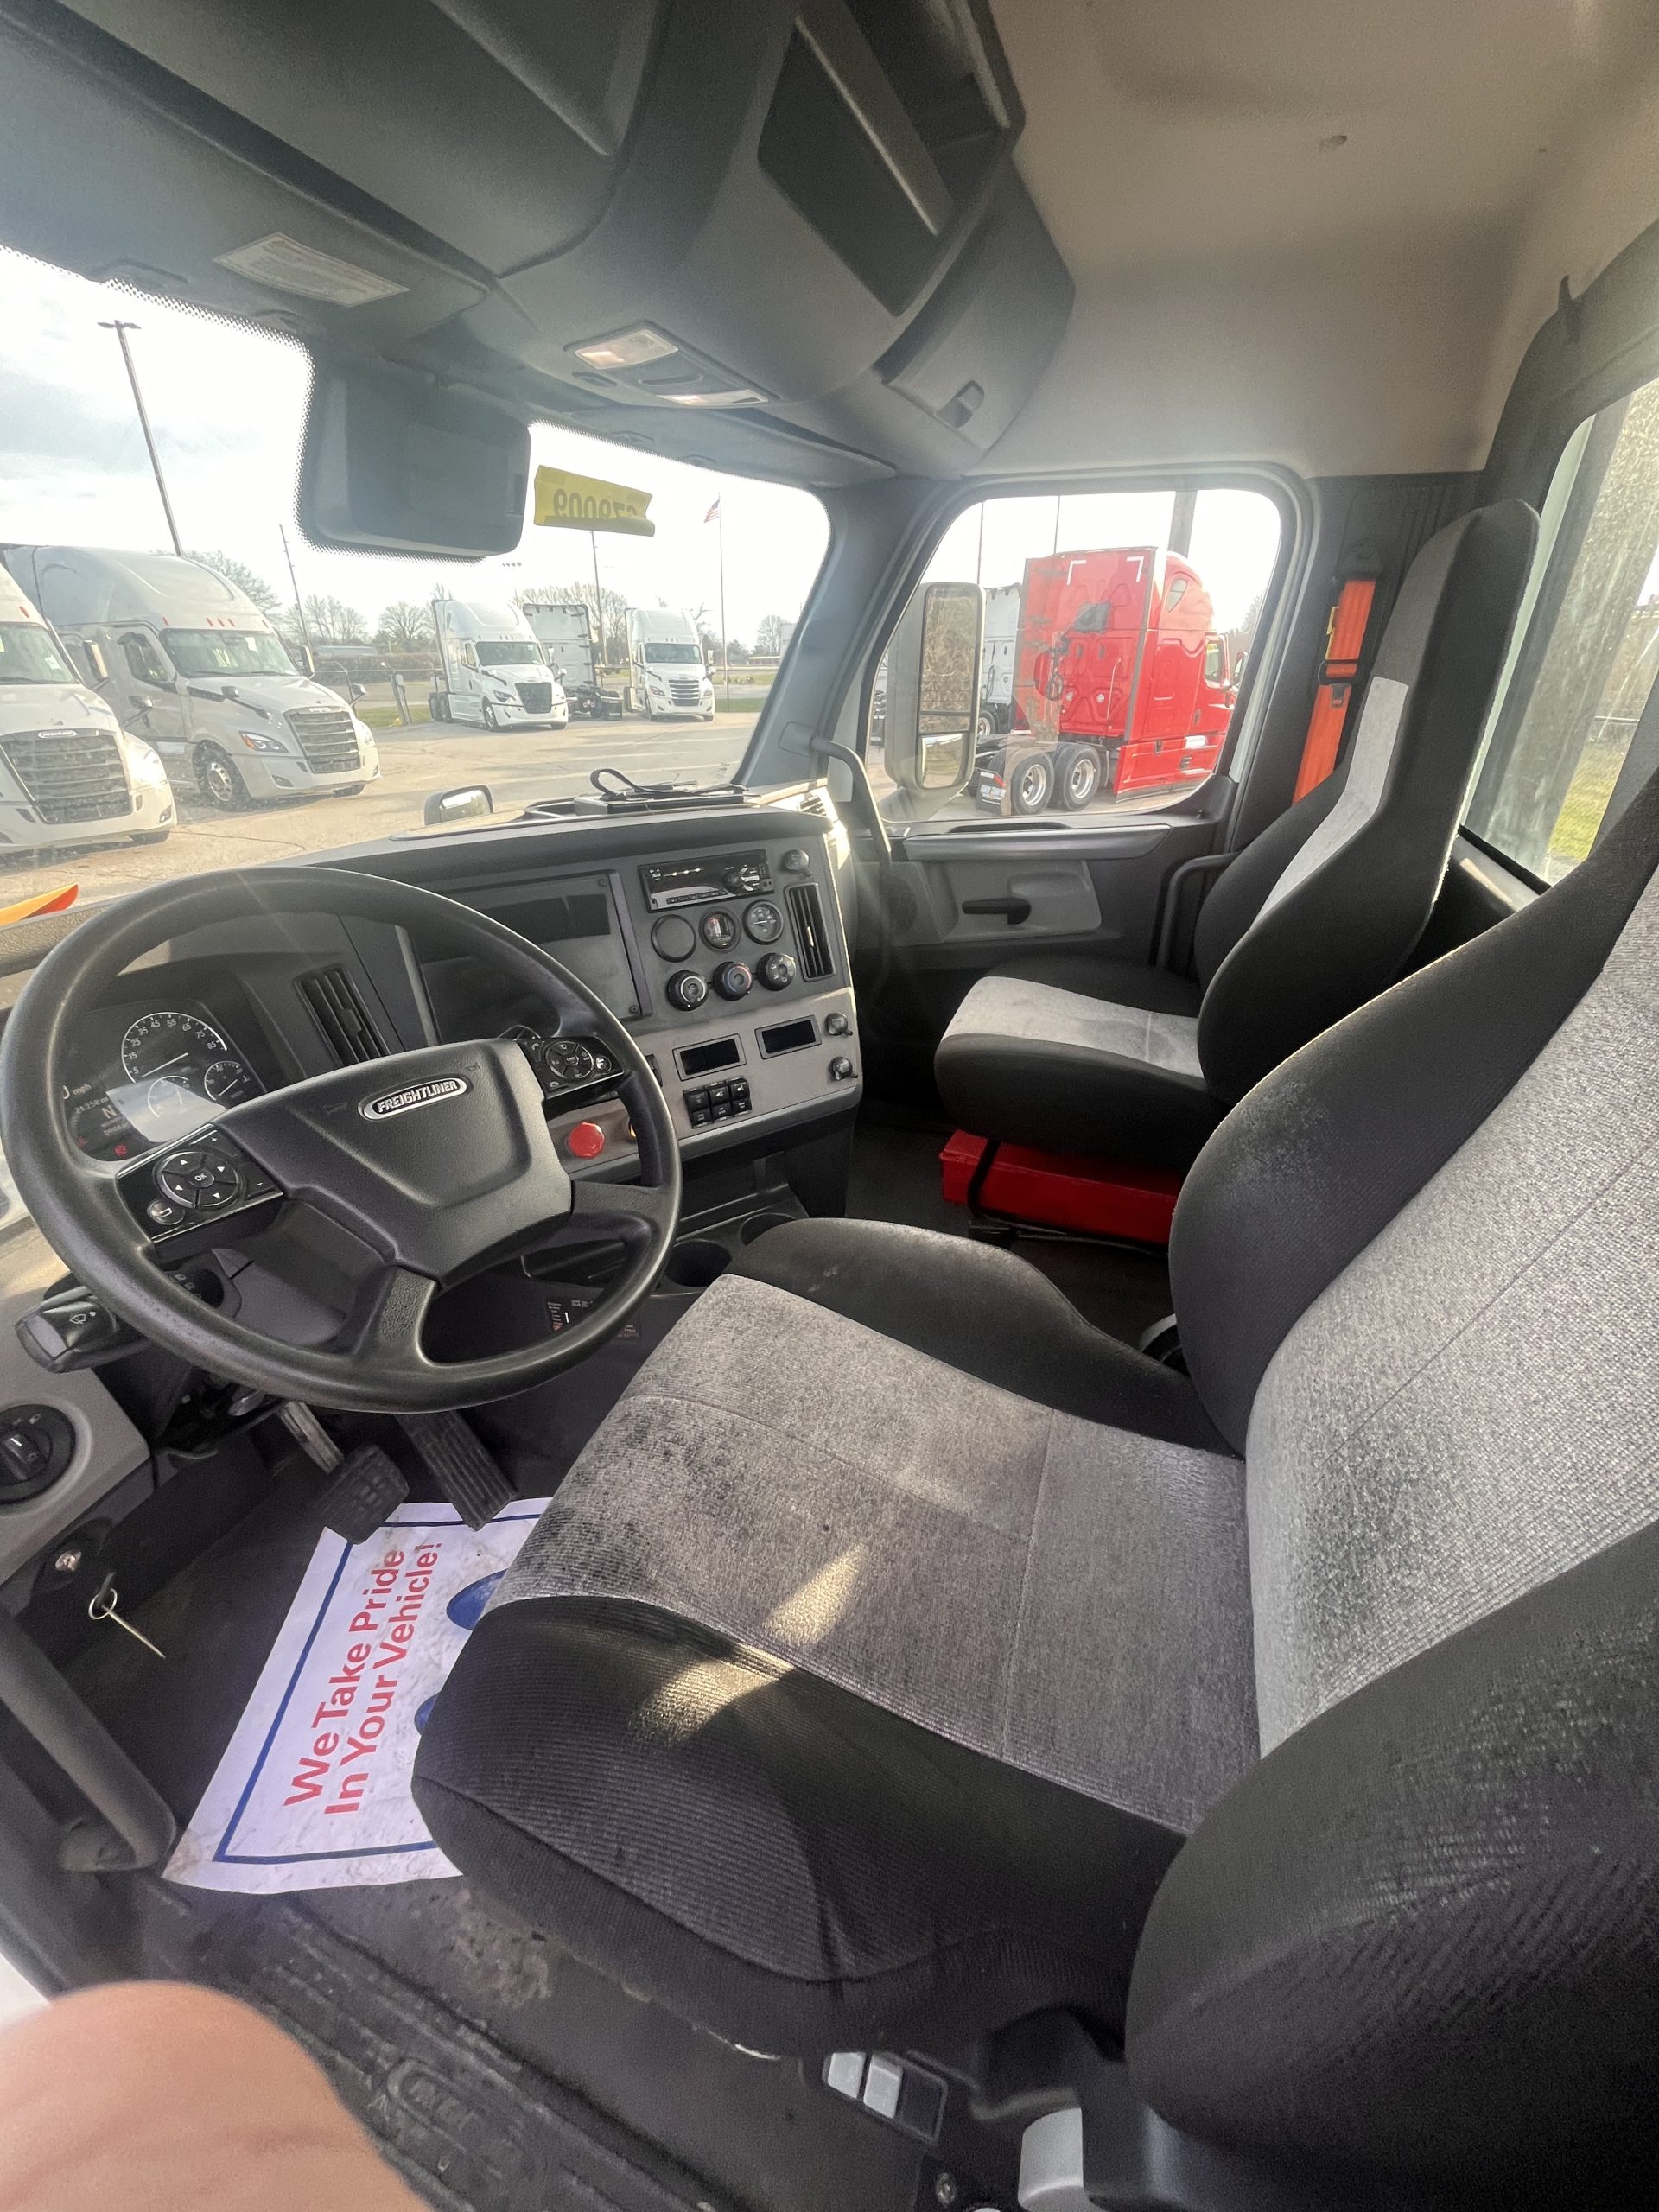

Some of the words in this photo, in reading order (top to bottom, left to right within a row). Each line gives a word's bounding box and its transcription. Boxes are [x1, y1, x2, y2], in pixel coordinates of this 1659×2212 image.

[167, 1019, 177, 1027] 55
[182, 1022, 191, 1031] 65
[138, 1027, 148, 1035] 35
[195, 1030, 205, 1039] 75
[130, 1038, 141, 1046] 25
[73, 1084, 92, 1096] mph
[378, 1080, 458, 1113] FREIGHTLINER
[101, 1104, 118, 1119] N
[194, 1173, 207, 1181] OK
[348, 1549, 405, 1632] Pride
[372, 1542, 442, 1669] Vehicle!
[311, 1643, 371, 1729] Take
[340, 1674, 398, 1766] Your
[283, 1732, 340, 1807] We
[323, 1772, 370, 1815] In
